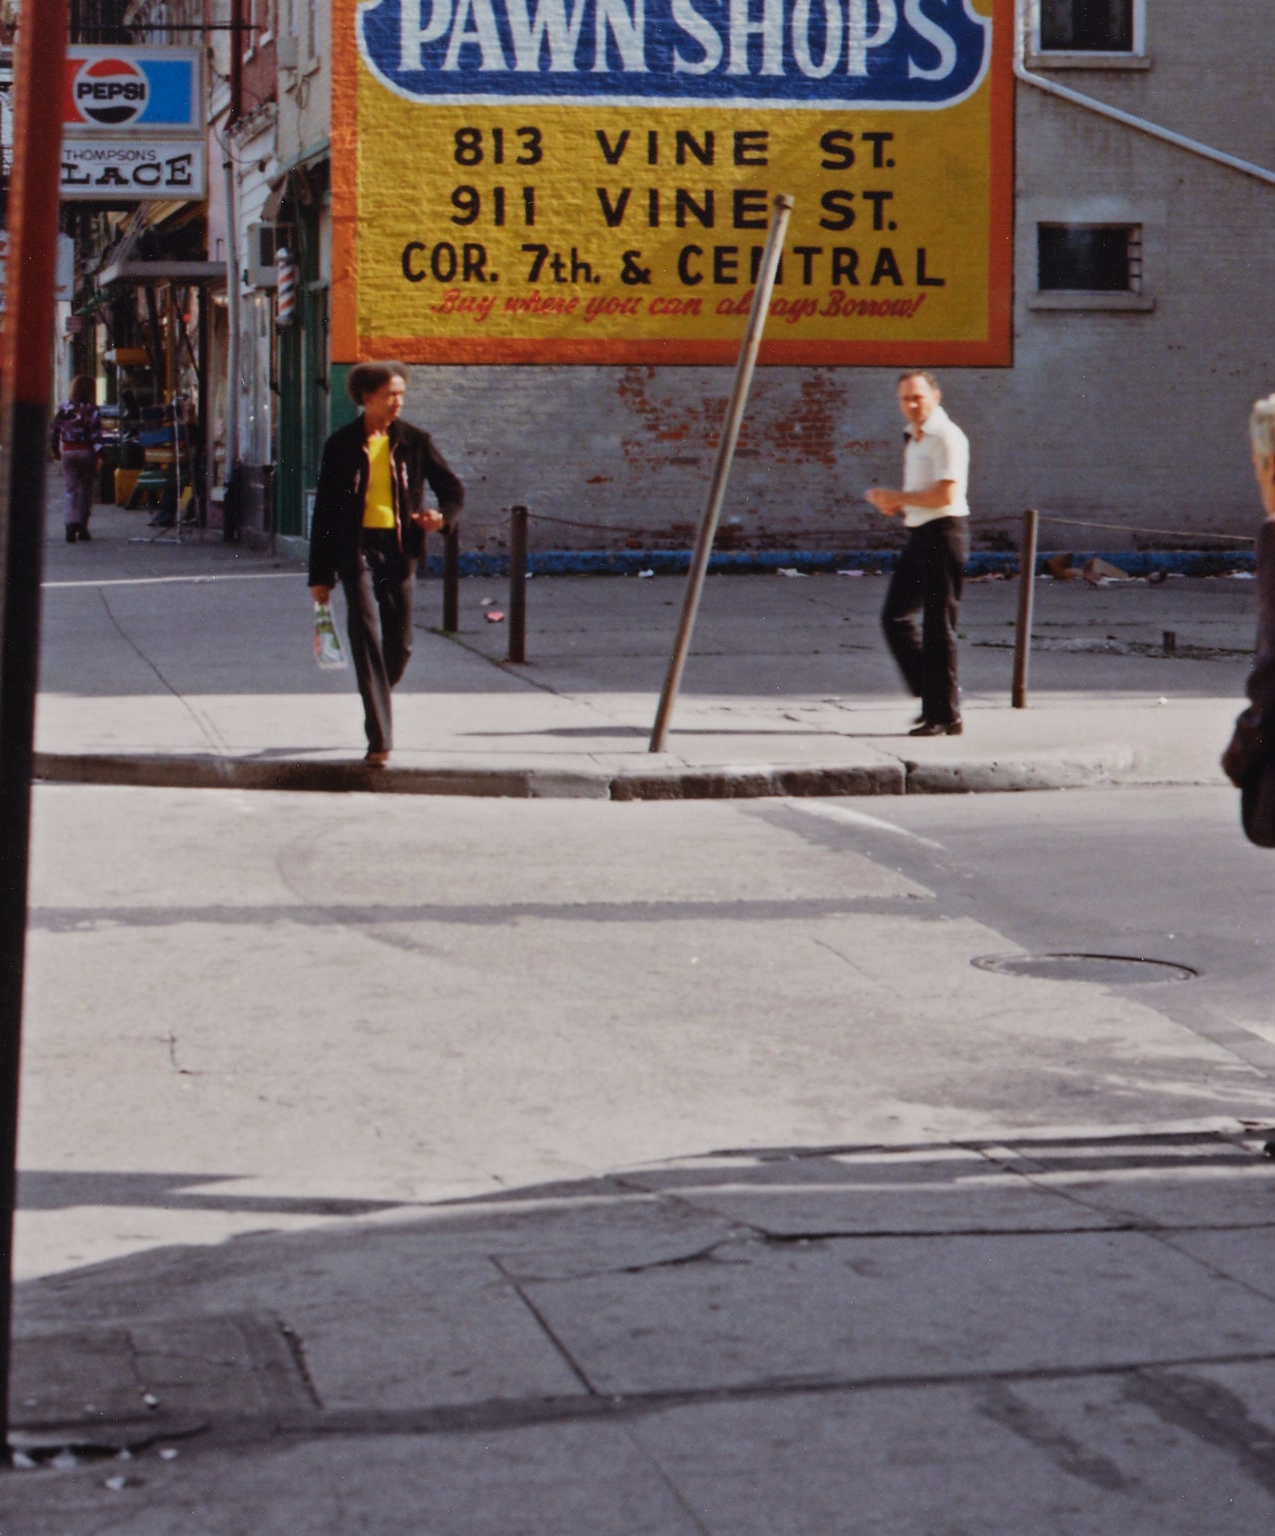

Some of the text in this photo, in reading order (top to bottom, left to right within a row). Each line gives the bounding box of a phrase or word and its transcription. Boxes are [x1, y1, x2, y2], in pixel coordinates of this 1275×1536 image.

[76, 82, 146, 100] PEPSI
[453, 126, 896, 171] 813 VINE ST.
[61, 152, 192, 187] LACE
[449, 184, 898, 231] 911 VINE ST.
[401, 240, 500, 283] COR.
[521, 243, 601, 285] 7th.
[620, 246, 652, 285] &
[431, 289, 496, 323] Buy
[503, 288, 578, 316] where
[585, 295, 641, 323] you
[648, 294, 701, 316] can
[715, 289, 819, 324] alays
